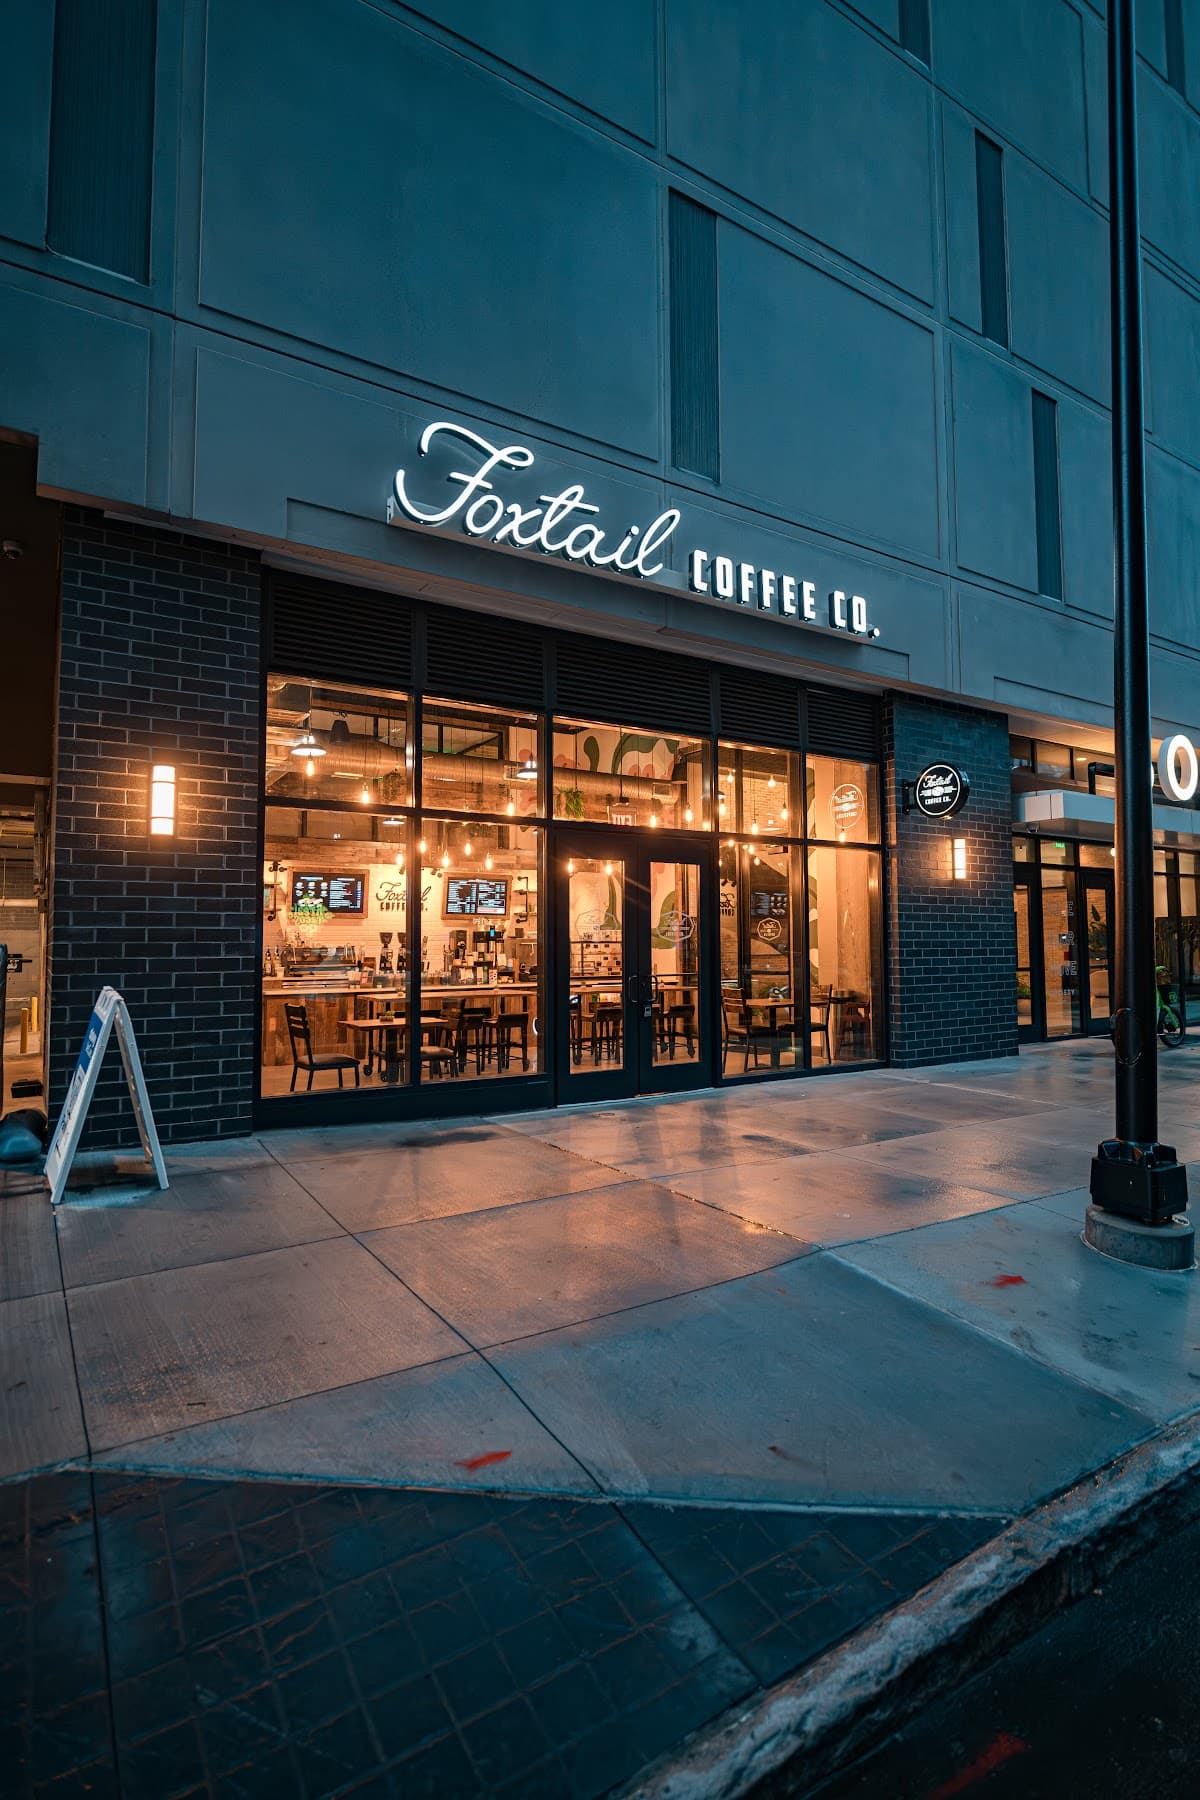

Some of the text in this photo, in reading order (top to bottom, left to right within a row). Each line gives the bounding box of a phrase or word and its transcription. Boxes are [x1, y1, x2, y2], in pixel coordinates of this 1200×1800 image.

[397, 422, 879, 638] Foxtail COFFEE CO.
